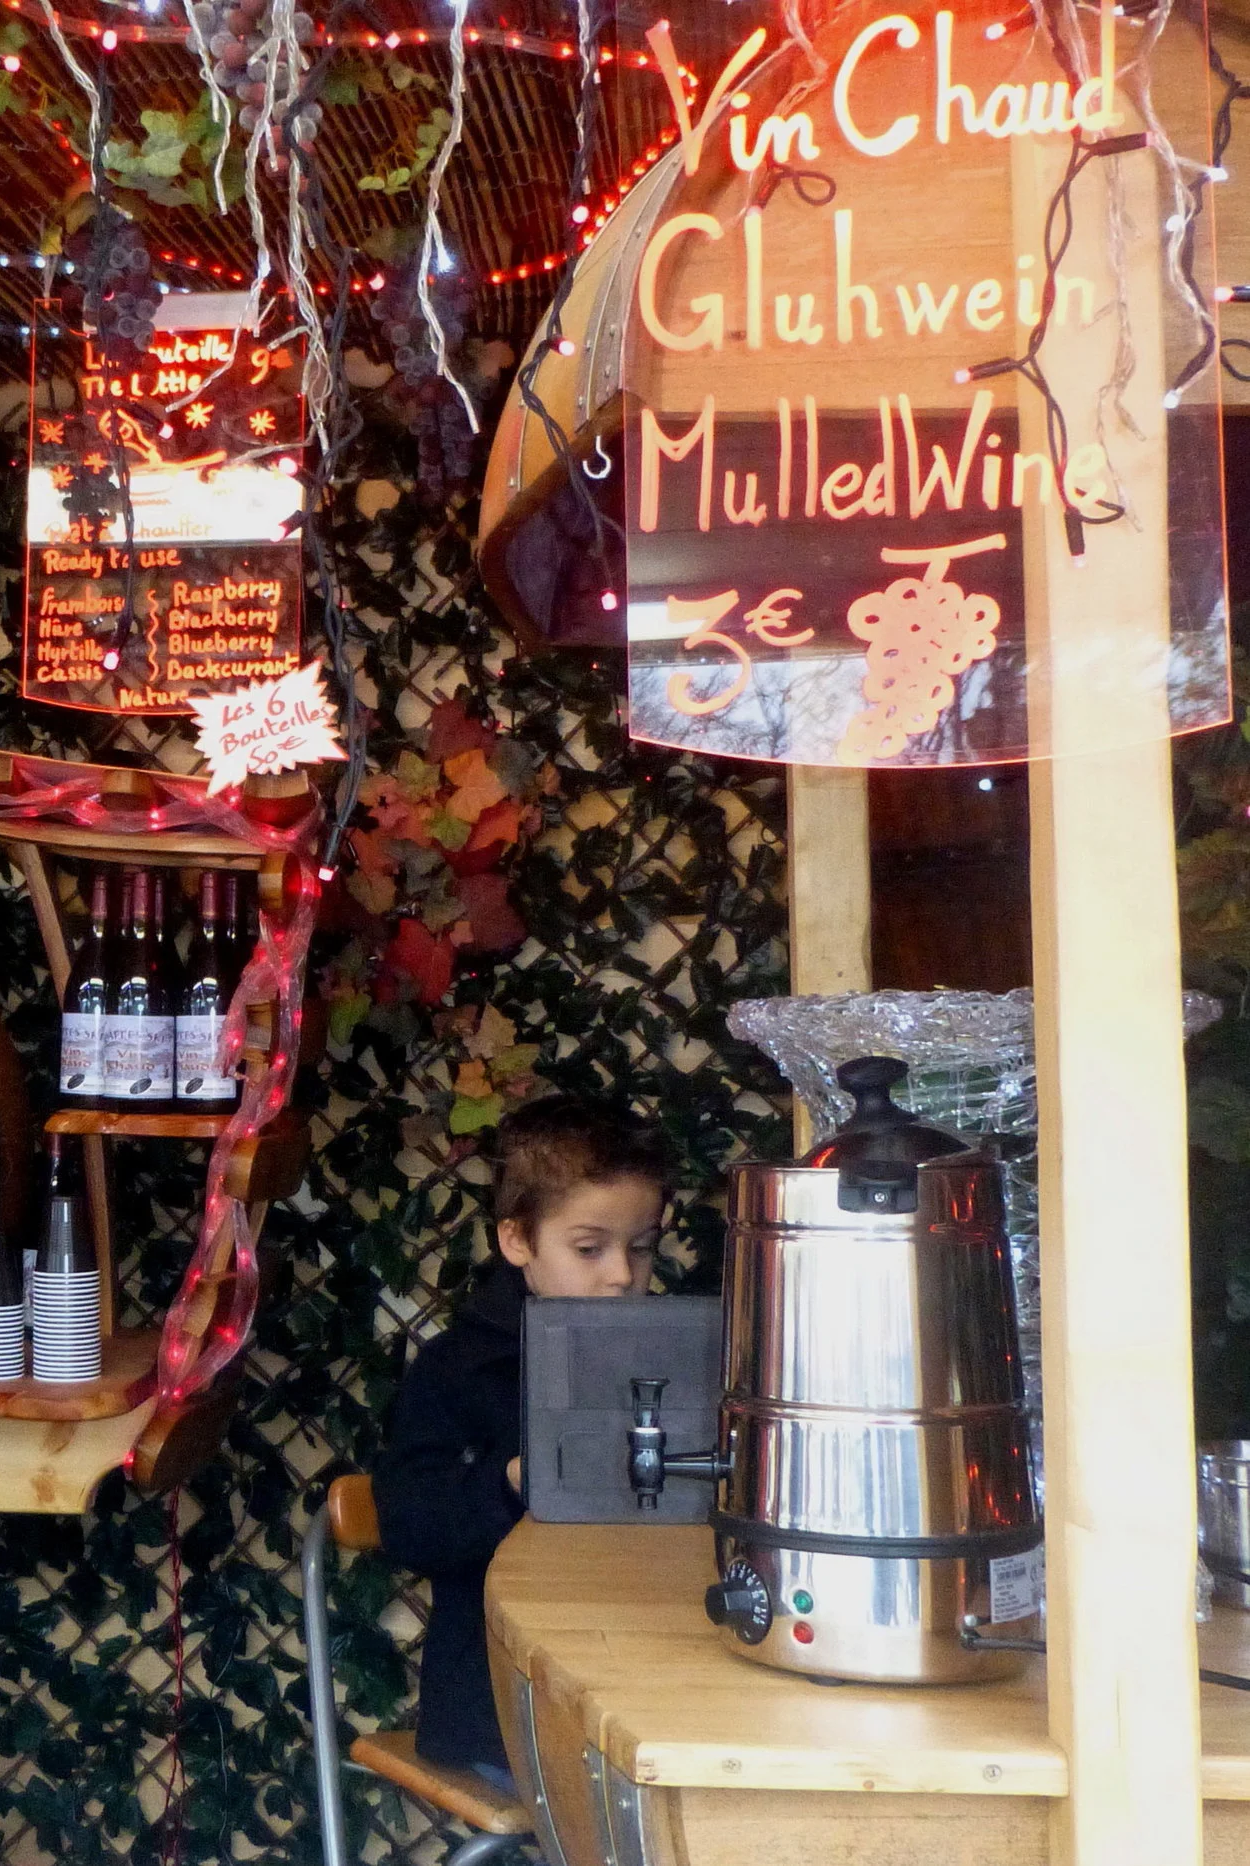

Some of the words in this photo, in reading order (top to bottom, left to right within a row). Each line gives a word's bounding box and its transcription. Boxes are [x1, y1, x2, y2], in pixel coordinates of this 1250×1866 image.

[646, 19, 821, 177] Vin
[833, 0, 1124, 157] Chaud
[639, 208, 1096, 352] Gluhwein
[639, 393, 896, 534] Mulled
[898, 389, 1108, 519] Wine
[42, 549, 103, 577] Ready
[139, 548, 182, 569] use
[173, 577, 281, 607] Raspberry
[168, 605, 279, 633] Blackberry
[168, 631, 273, 656] Blueberry
[222, 702, 254, 727] Les
[267, 686, 285, 716] 6
[219, 701, 329, 755] Bouteilles
